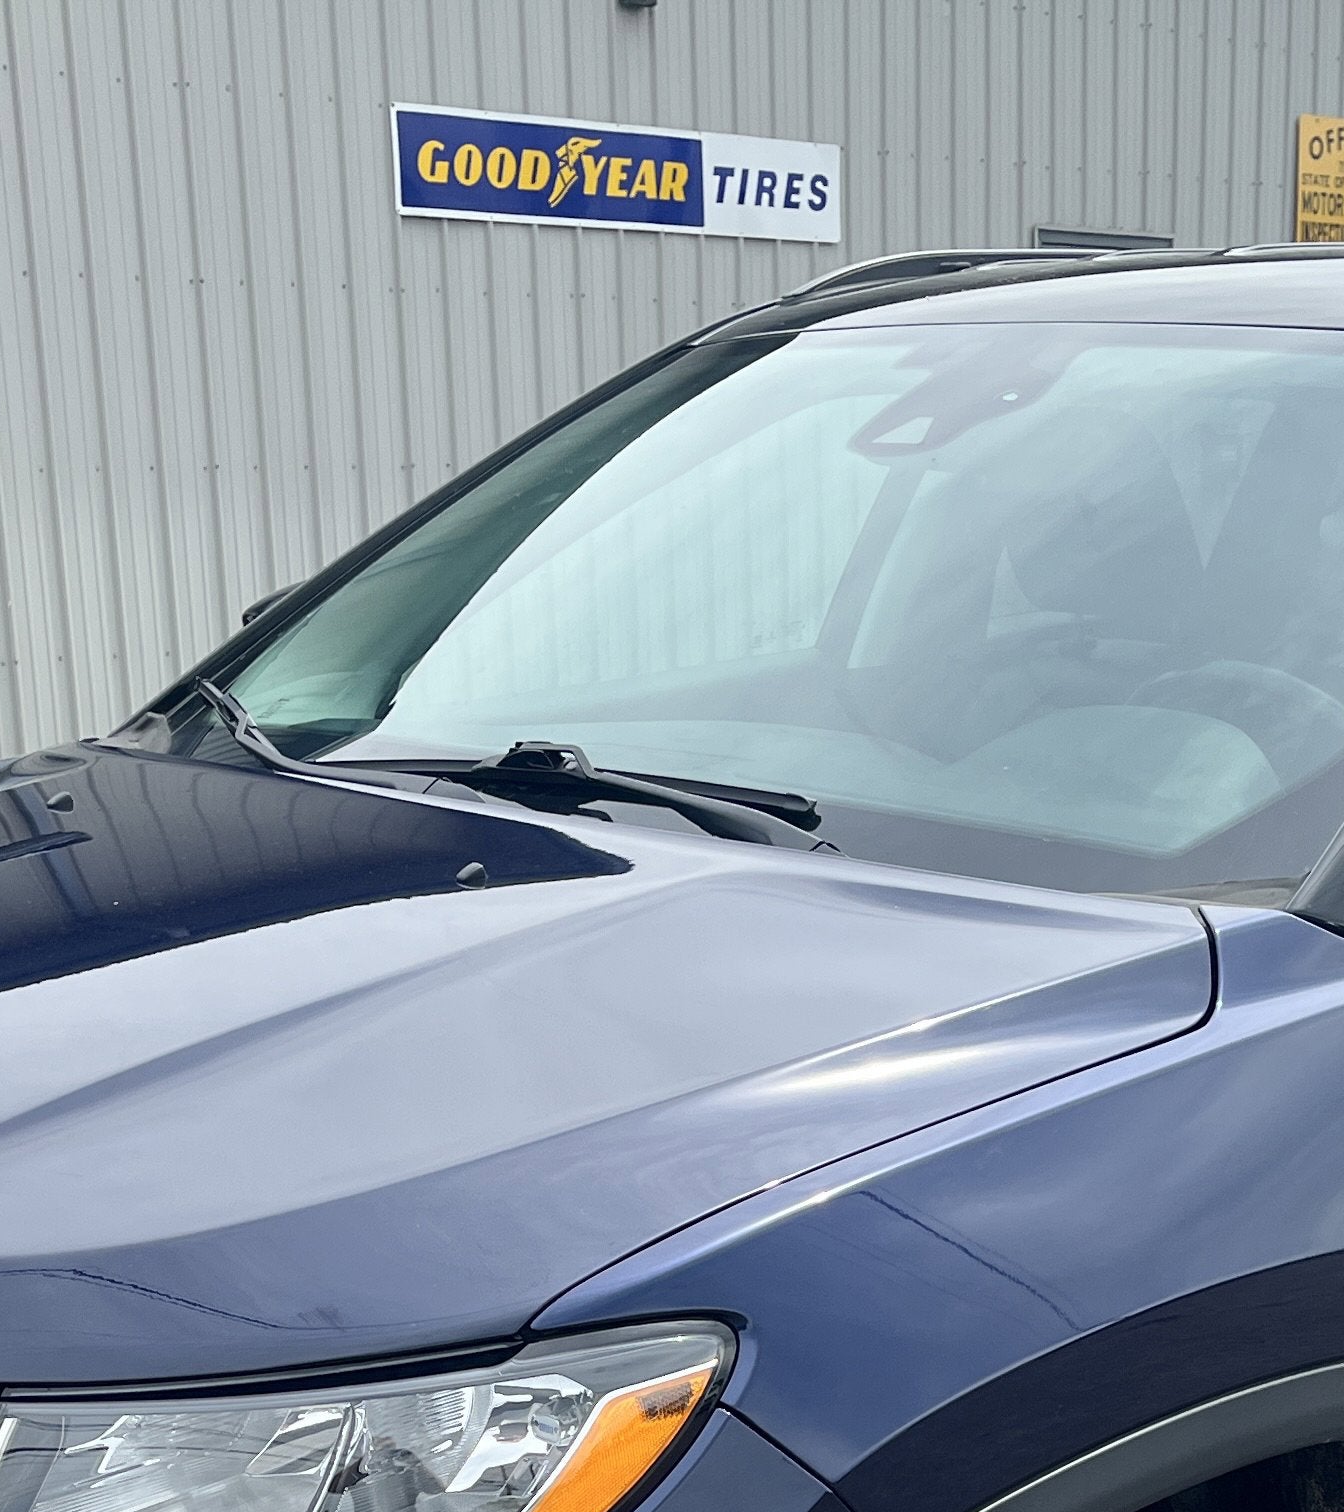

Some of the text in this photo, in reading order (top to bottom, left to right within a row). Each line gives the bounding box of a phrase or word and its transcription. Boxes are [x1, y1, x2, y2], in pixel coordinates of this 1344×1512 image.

[712, 165, 829, 212] TIRES
[1301, 172, 1330, 188] STATE
[1300, 190, 1344, 217] MOTOR
